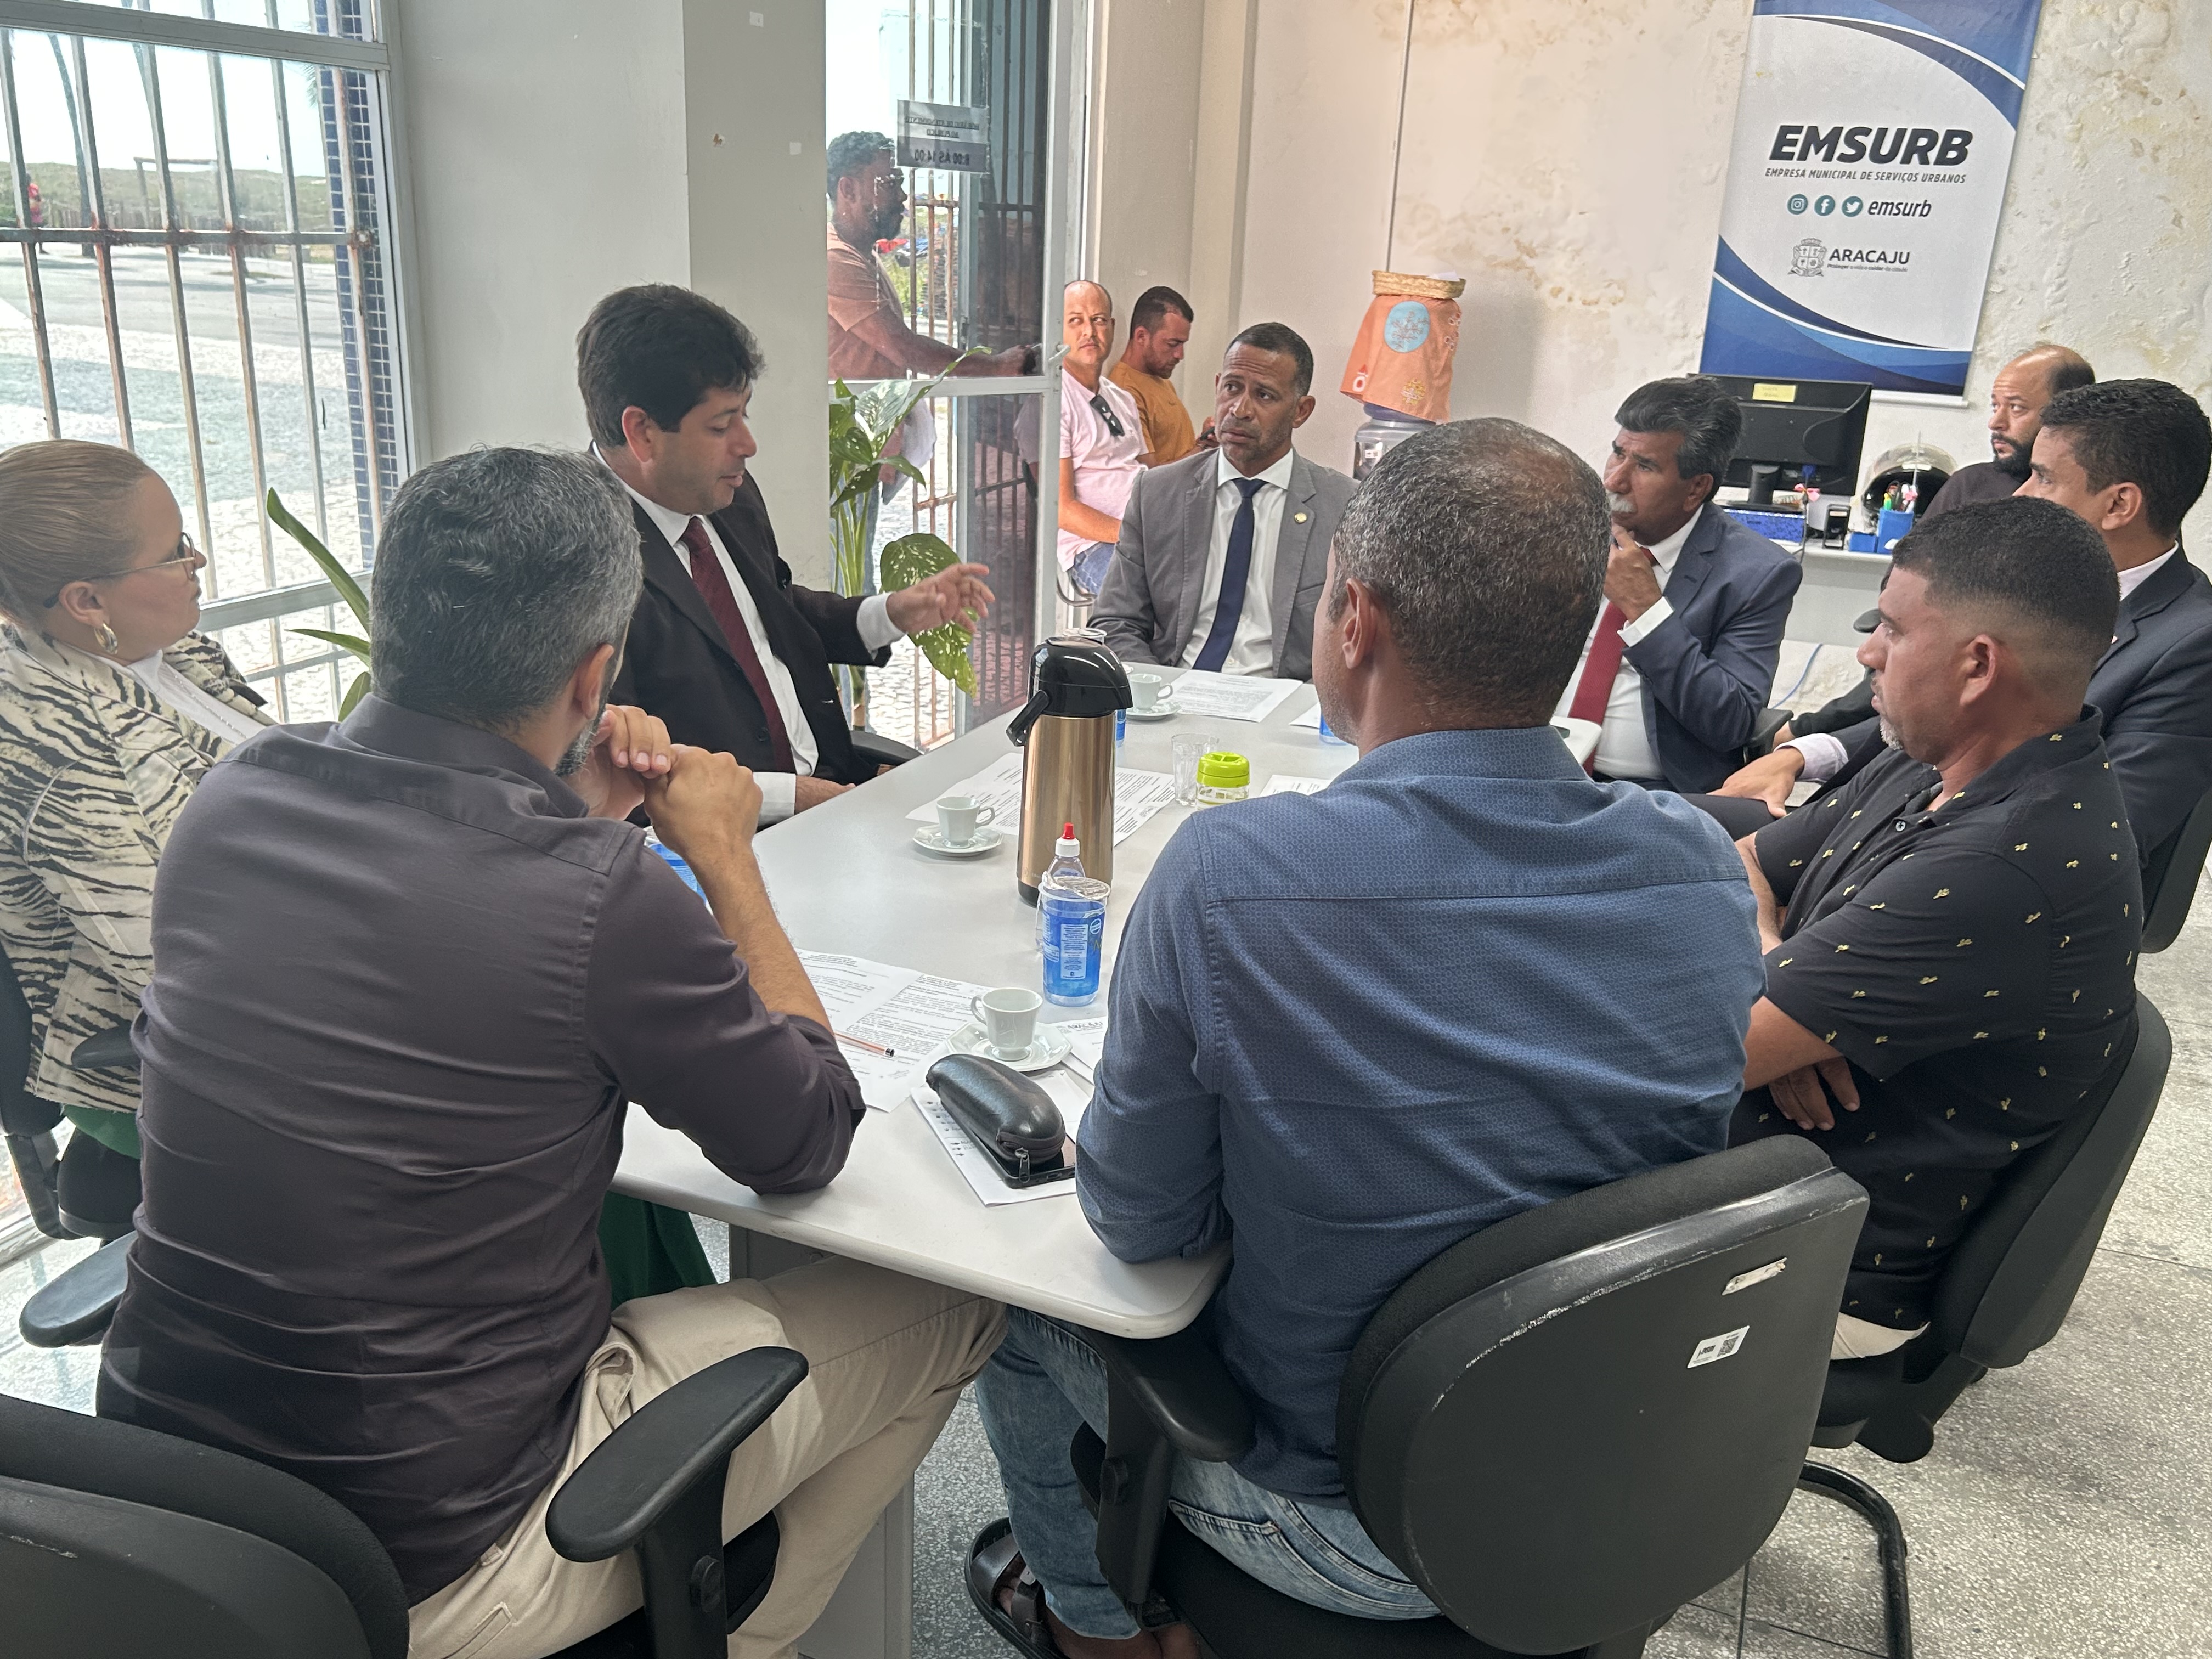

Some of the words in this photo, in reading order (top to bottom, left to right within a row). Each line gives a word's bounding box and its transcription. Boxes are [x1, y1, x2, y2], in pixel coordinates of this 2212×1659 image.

[1769, 125, 1974, 166] EMSURB
[1764, 168, 1807, 178] EMPRESA
[1808, 170, 1857, 180] MUNICIPAL
[1859, 171, 1873, 180] DE
[1874, 171, 1919, 183] SERVIÇOS
[1921, 173, 1966, 184] URBANOS
[1867, 199, 1932, 217] emsurb
[1829, 248, 1911, 264] ARACAJU
